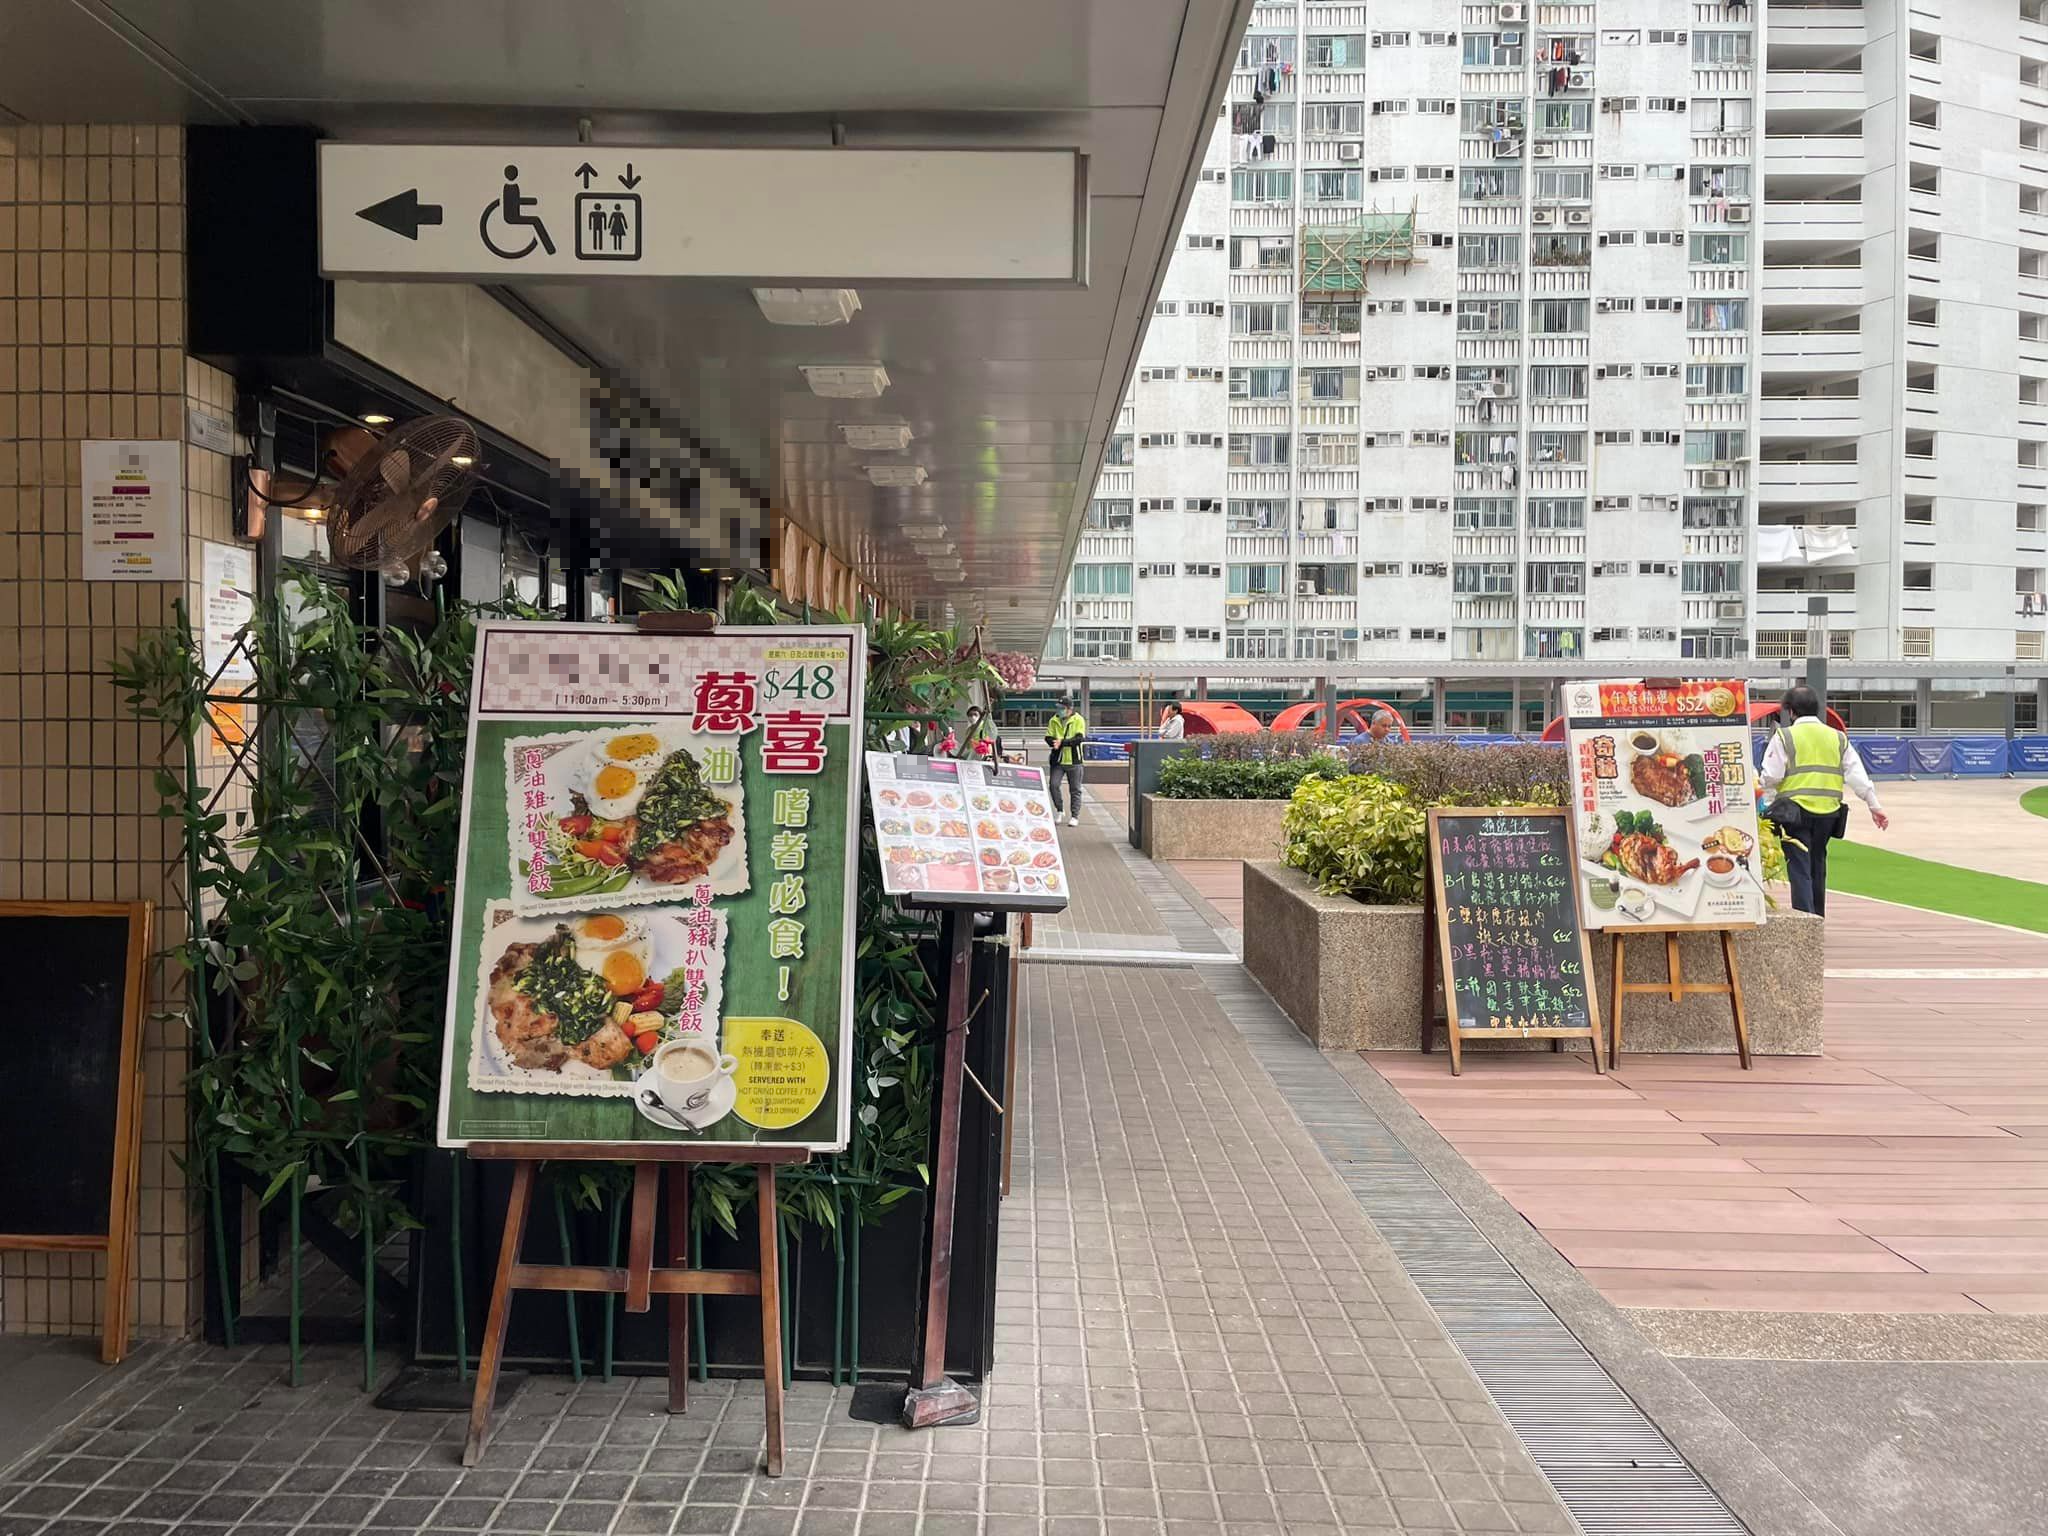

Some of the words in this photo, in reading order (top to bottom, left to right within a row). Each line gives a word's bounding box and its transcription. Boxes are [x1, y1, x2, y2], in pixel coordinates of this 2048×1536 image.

[563, 694, 608, 705] 11:00am
[622, 695, 660, 707] 5:30pm
[763, 664, 835, 702] $48
[1676, 696, 1705, 712] $52
[1703, 750, 1722, 814] 西冷牛扒
[523, 749, 551, 892] 蔥油雞扒雙春飯
[680, 884, 713, 1032] 蔥油豬扒雙春飯
[775, 1087, 799, 1096] COFFEE
[805, 1087, 817, 1095] TEA
